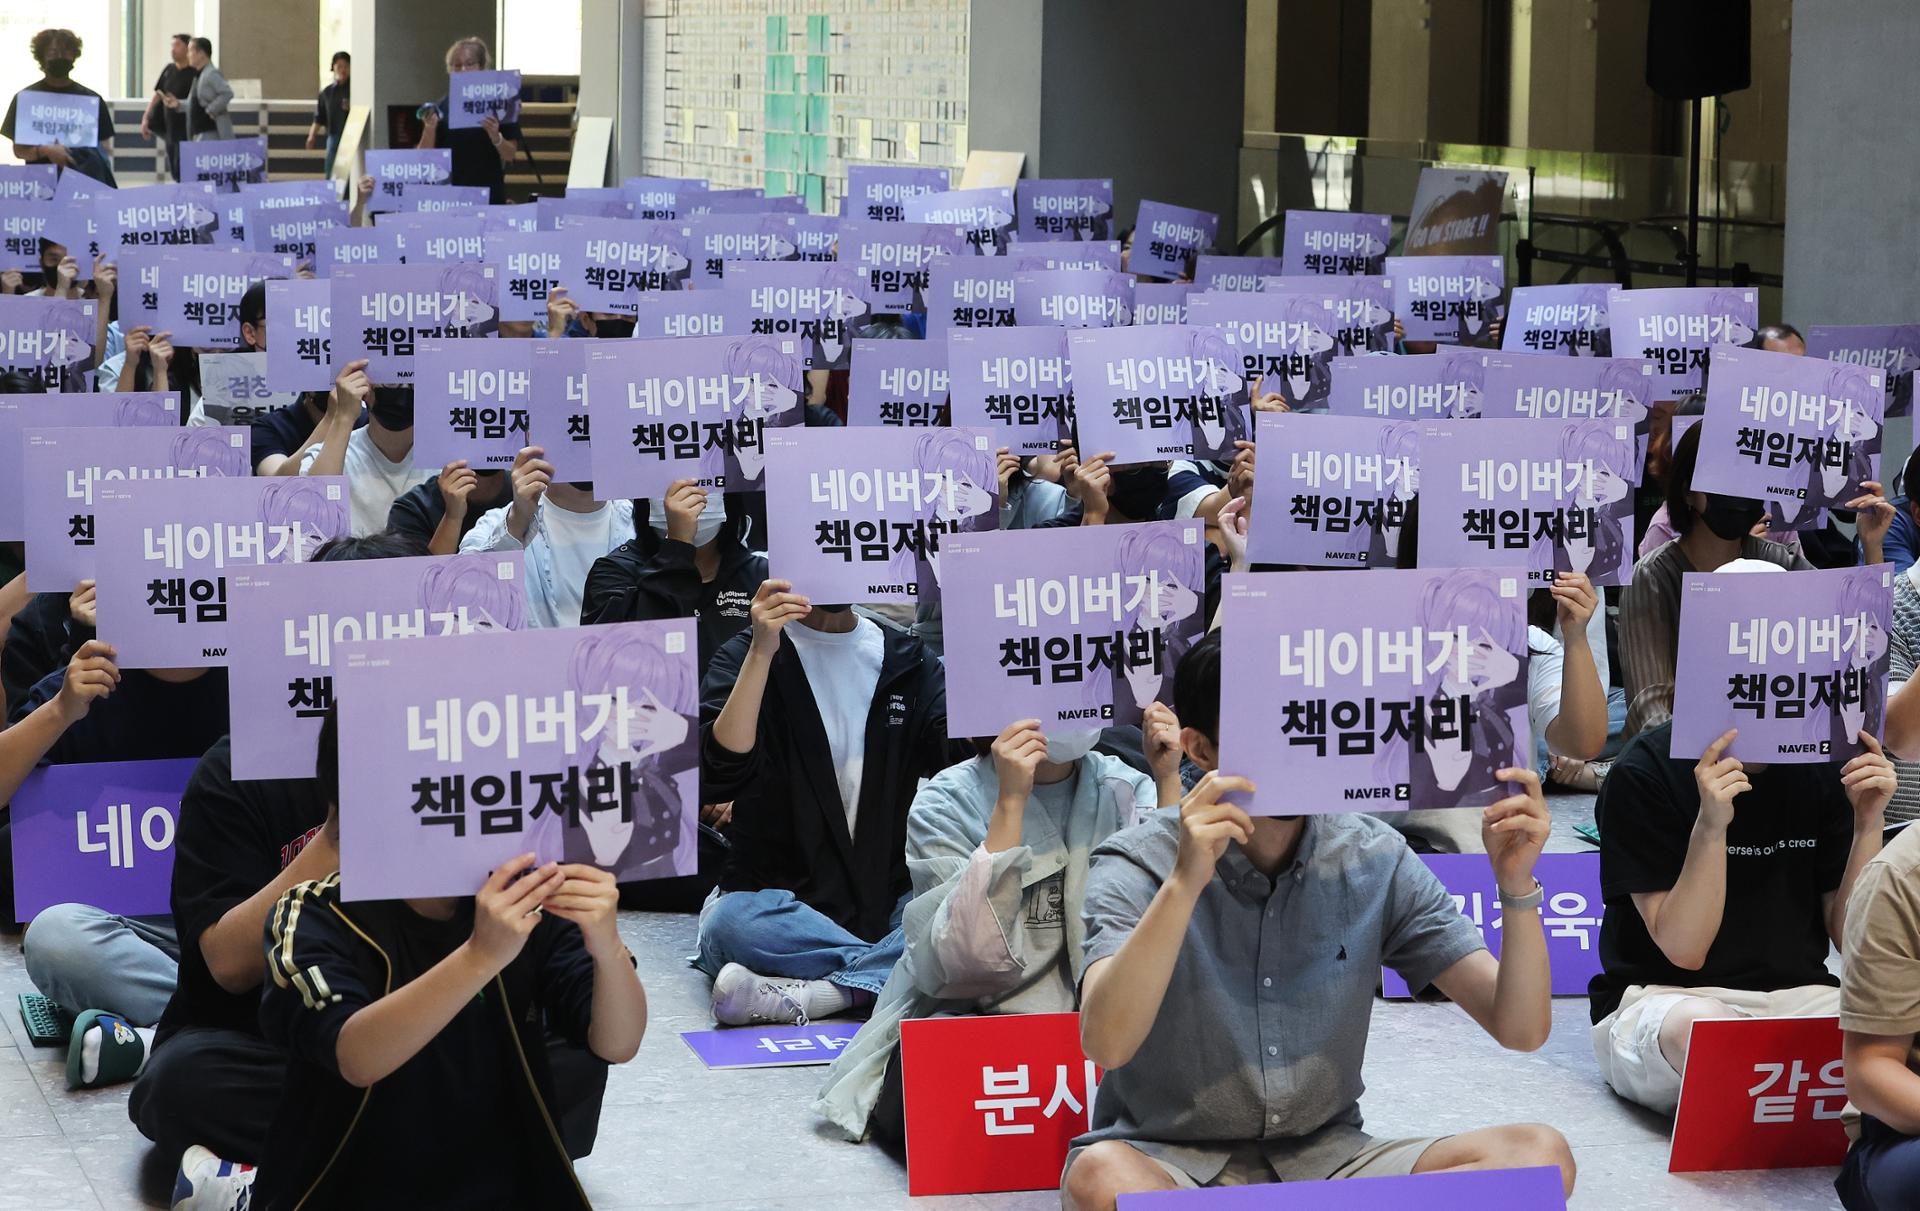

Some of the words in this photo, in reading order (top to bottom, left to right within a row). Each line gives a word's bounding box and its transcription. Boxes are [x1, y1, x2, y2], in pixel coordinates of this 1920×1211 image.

[462, 82, 509, 98] 네이버가
[31, 104, 83, 122] 네이버가
[195, 153, 251, 170] 네이버가
[381, 163, 437, 179] 네이버가
[0, 181, 41, 198] 이버가
[640, 192, 675, 207] 네이
[117, 203, 197, 228] 네이버가
[868, 206, 904, 222] 책임
[925, 206, 996, 226] 네이버가
[1033, 196, 1096, 214] 네이버가
[4, 218, 46, 234] 네이
[966, 228, 997, 246] 져라
[1152, 221, 1205, 246] 네이버가
[5, 238, 37, 256] 책임
[334, 244, 378, 263] 네이
[427, 236, 486, 259] 네이버
[586, 240, 669, 268] 네이버가
[705, 234, 778, 255] 네이버가
[1150, 241, 1197, 262] 책임져
[1304, 231, 1373, 253] 네이버가
[861, 243, 945, 267] 네이버가
[183, 274, 268, 299] 네이버
[509, 278, 559, 300] 책임
[953, 279, 1015, 303] 네이버
[1212, 274, 1265, 292] 네이버
[1408, 275, 1485, 297] 네이버가
[362, 292, 469, 322] 네이버가
[751, 287, 846, 314] 네이버가
[1041, 295, 1121, 323] 네이버가
[184, 302, 241, 326] 책임
[664, 313, 723, 337] 네이
[953, 307, 1016, 327] 책임져
[1526, 304, 1599, 326] 네이버가
[1639, 314, 1732, 343] 네이버가
[0, 329, 70, 361] 이버가
[1243, 354, 1315, 382] 임져라
[1643, 347, 1711, 375] 책임져
[449, 369, 530, 401] 네이버
[880, 367, 950, 397] 네이버
[1107, 356, 1220, 392] 네이버가
[627, 372, 766, 416] 네이버가
[1364, 381, 1469, 416] 네이버가
[1515, 387, 1625, 418] 네이버가
[880, 402, 946, 426] 책임
[985, 394, 1075, 425] 책임져
[1113, 395, 1227, 430] 책임져라
[1740, 386, 1854, 434] 네이버가
[1157, 446, 1184, 454] NAVER
[1736, 427, 1853, 476] 책임져라
[695, 479, 713, 487] VER
[1291, 450, 1414, 493] 네이버가
[1461, 459, 1597, 501] 네이버가
[811, 468, 959, 512] 네이버가
[1767, 486, 1795, 497] NAVER
[1462, 507, 1600, 550] 책임져라
[144, 521, 308, 569] 네이버가
[1325, 552, 1356, 560] NAVER
[146, 576, 228, 623] 책임
[868, 585, 904, 594] NAVER
[993, 569, 1164, 627] 네이버가
[1728, 612, 1870, 664] 네이버가
[202, 648, 228, 657] NAV
[999, 627, 1166, 686] 책임져라
[1279, 625, 1474, 688] 네이버가
[1726, 666, 1871, 719] 책임져라
[406, 686, 636, 763] 네이버가
[1058, 709, 1098, 720] NAVER
[1281, 694, 1478, 757] 책임져라
[1778, 743, 1816, 753] NAVER
[411, 761, 640, 837] 책임져라
[1344, 788, 1391, 800] NAVER
[76, 800, 182, 869] 네이
